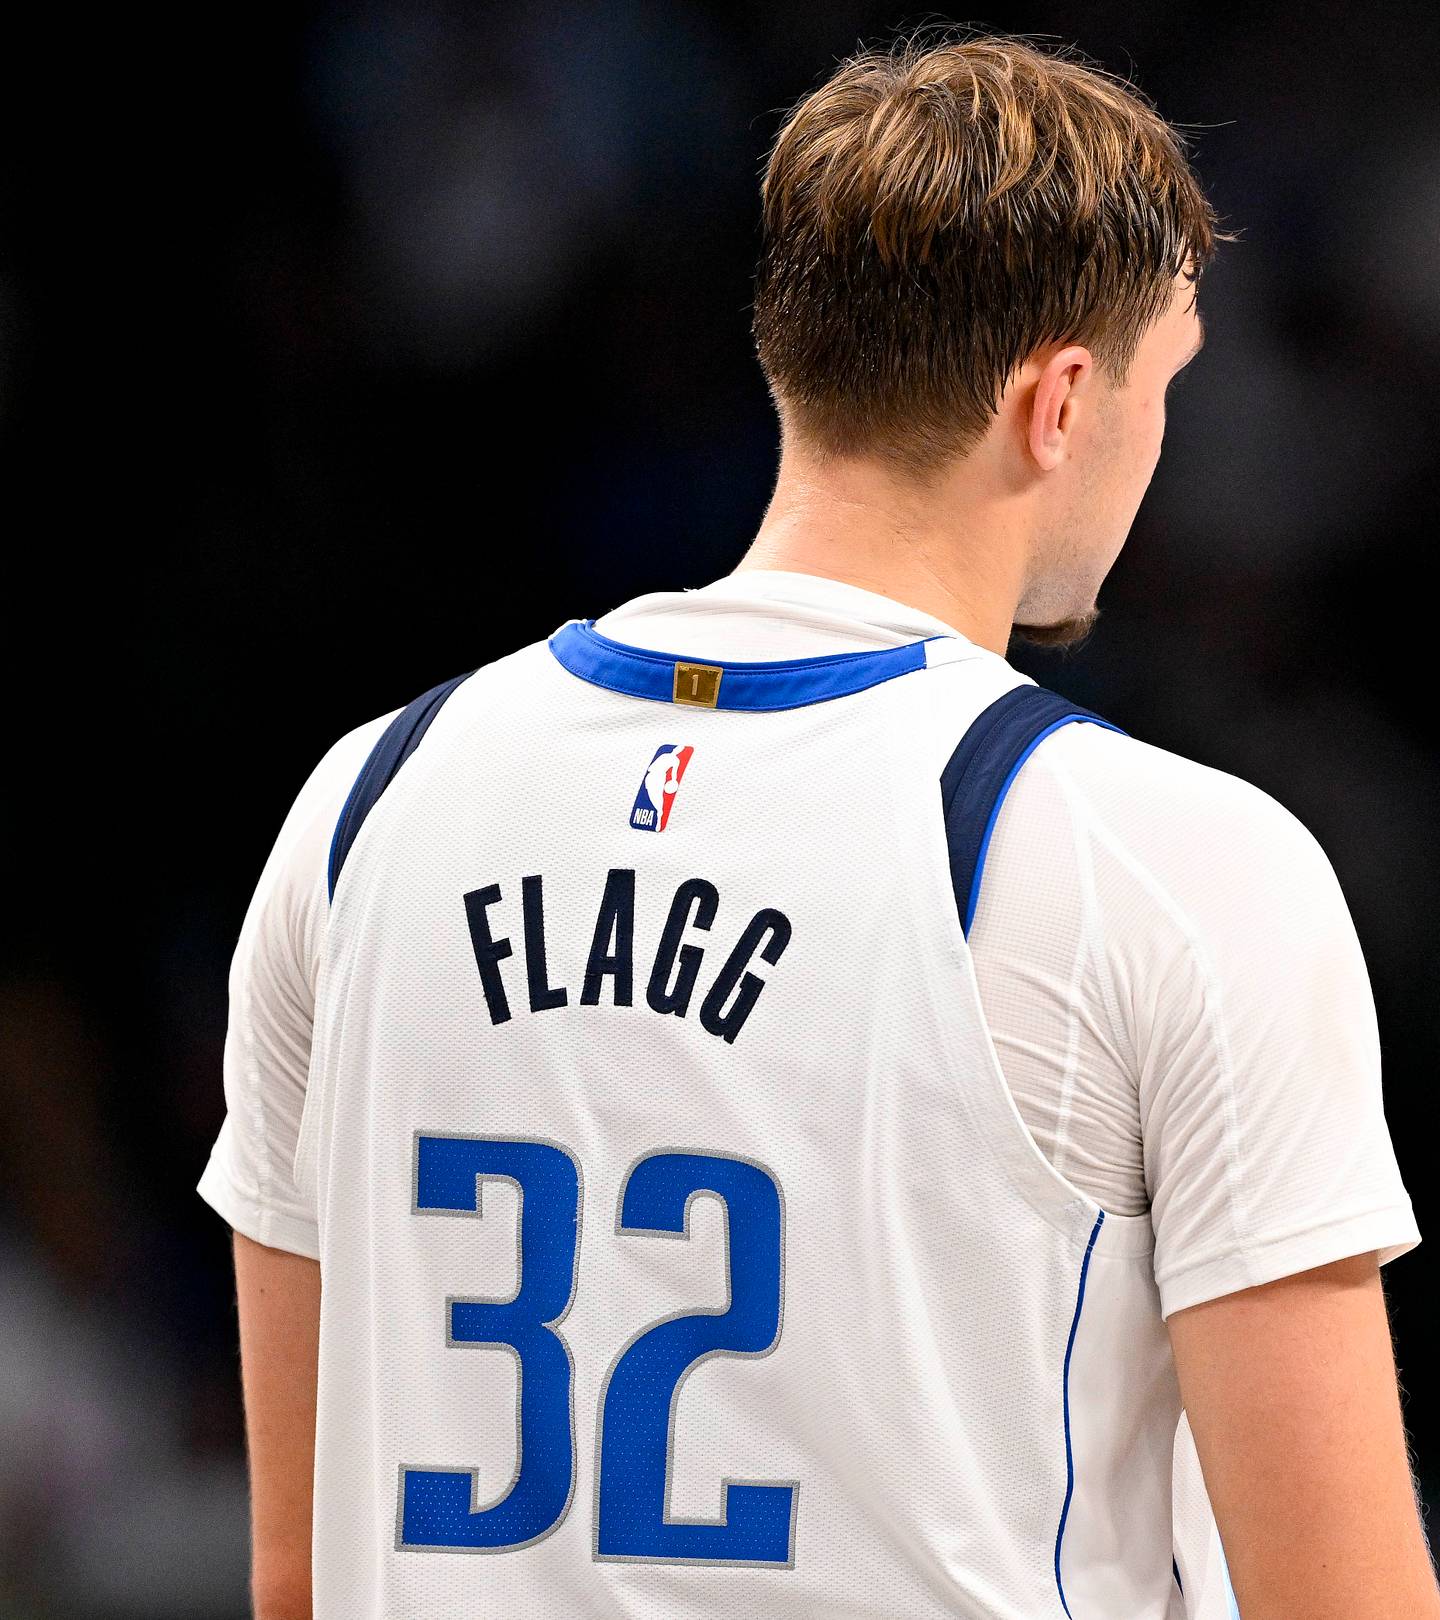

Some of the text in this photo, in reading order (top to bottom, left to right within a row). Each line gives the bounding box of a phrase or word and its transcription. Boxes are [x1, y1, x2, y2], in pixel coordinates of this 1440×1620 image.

[632, 807, 654, 826] NBA
[463, 869, 792, 1045] FLAGG
[394, 1129, 799, 1570] 32
